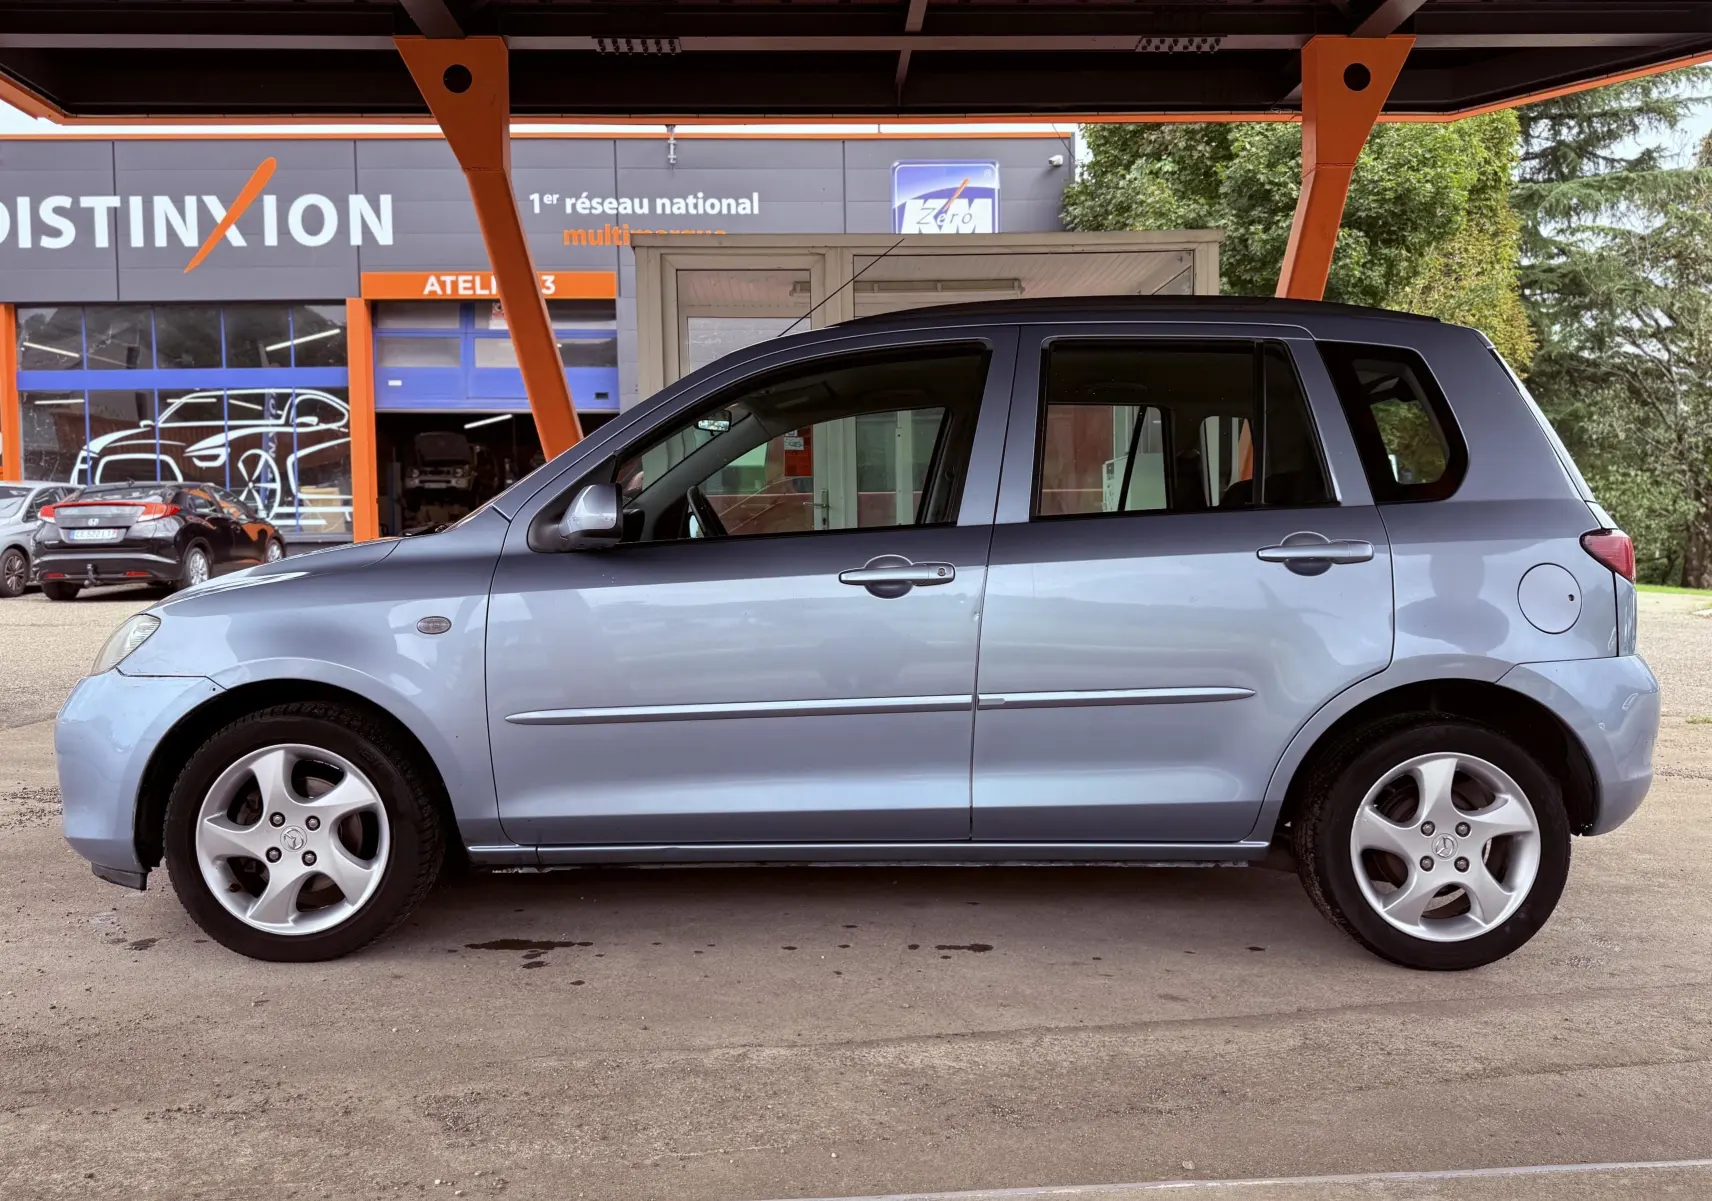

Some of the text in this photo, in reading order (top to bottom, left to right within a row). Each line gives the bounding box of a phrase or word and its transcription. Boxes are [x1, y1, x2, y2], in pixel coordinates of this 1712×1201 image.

[529, 192, 760, 215] 1er réseau national
[423, 275, 556, 295] ATELI 3
